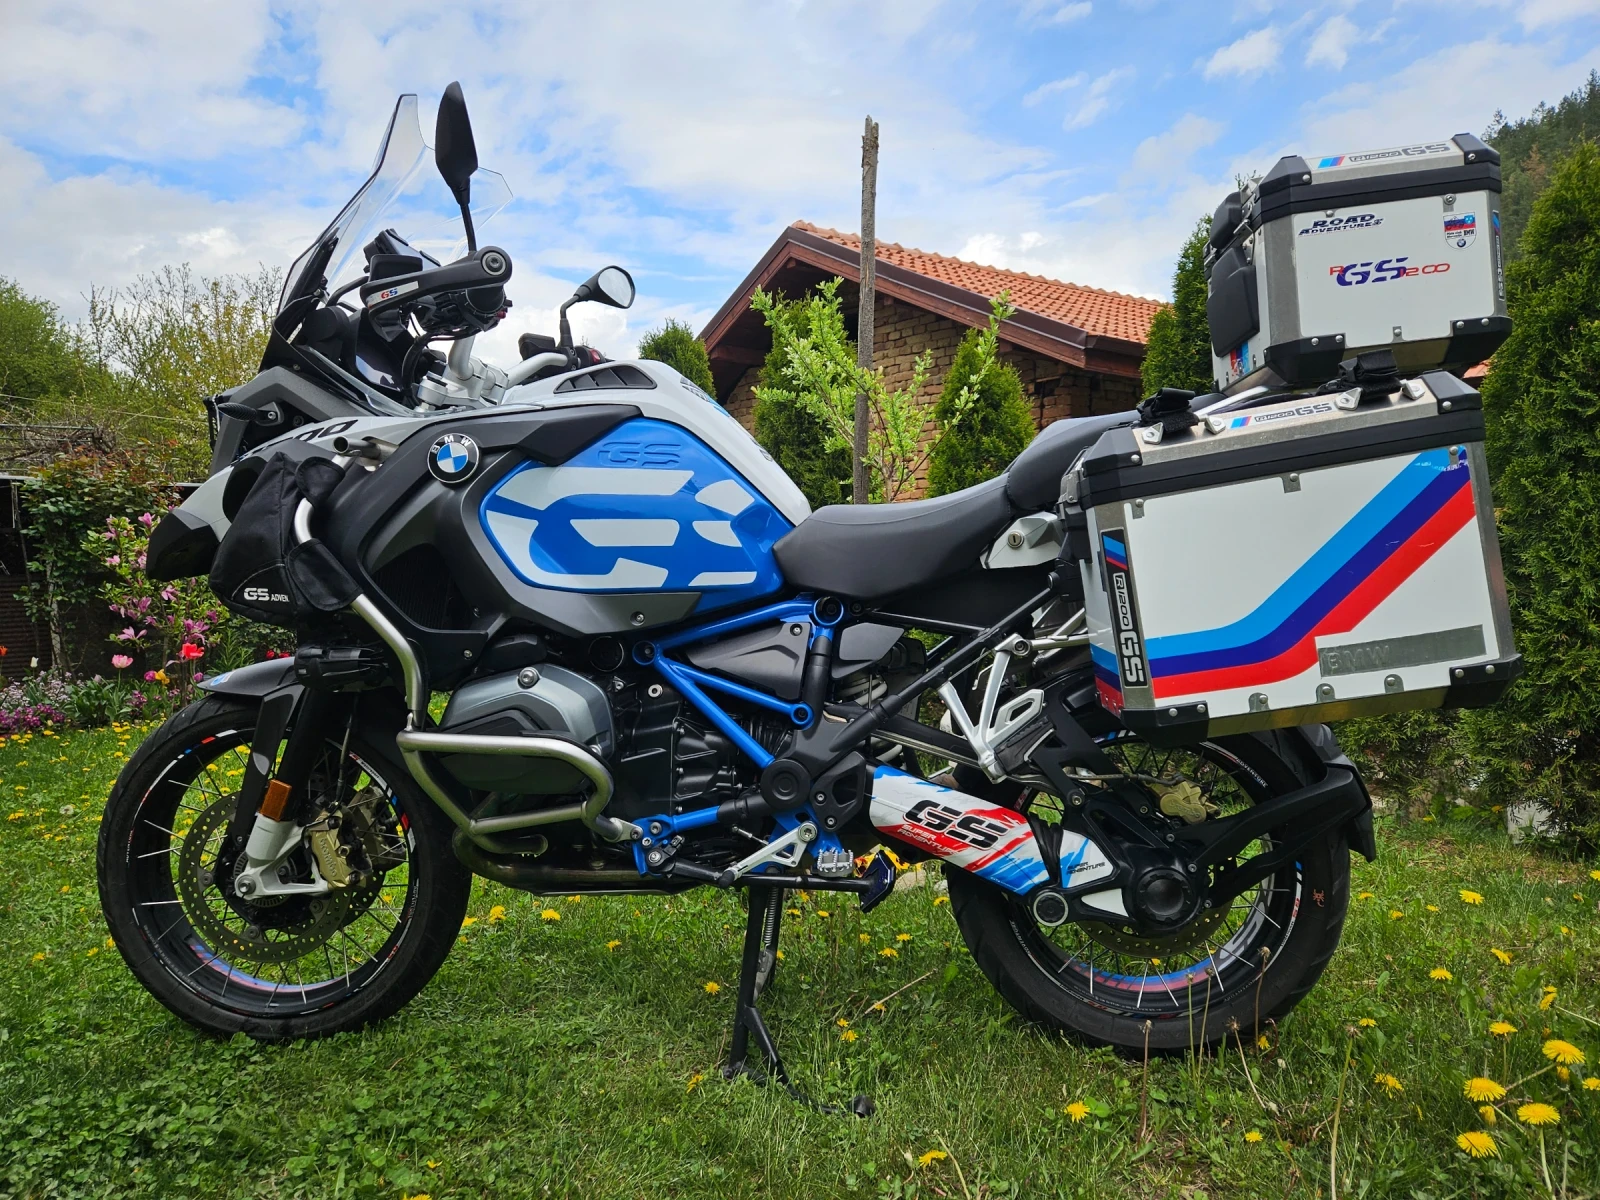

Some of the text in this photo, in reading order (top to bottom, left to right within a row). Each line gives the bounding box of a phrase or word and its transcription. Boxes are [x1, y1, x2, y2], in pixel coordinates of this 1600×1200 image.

[1312, 214, 1375, 228] ROAD
[1336, 257, 1409, 286] GS
[381, 288, 398, 299] GS
[431, 434, 472, 454] BMW
[597, 442, 681, 469] GS
[243, 588, 270, 600] GS
[1120, 631, 1145, 682] GS
[1326, 645, 1390, 671] BMW
[901, 824, 937, 841] SUPER
[903, 799, 1009, 851] GS
